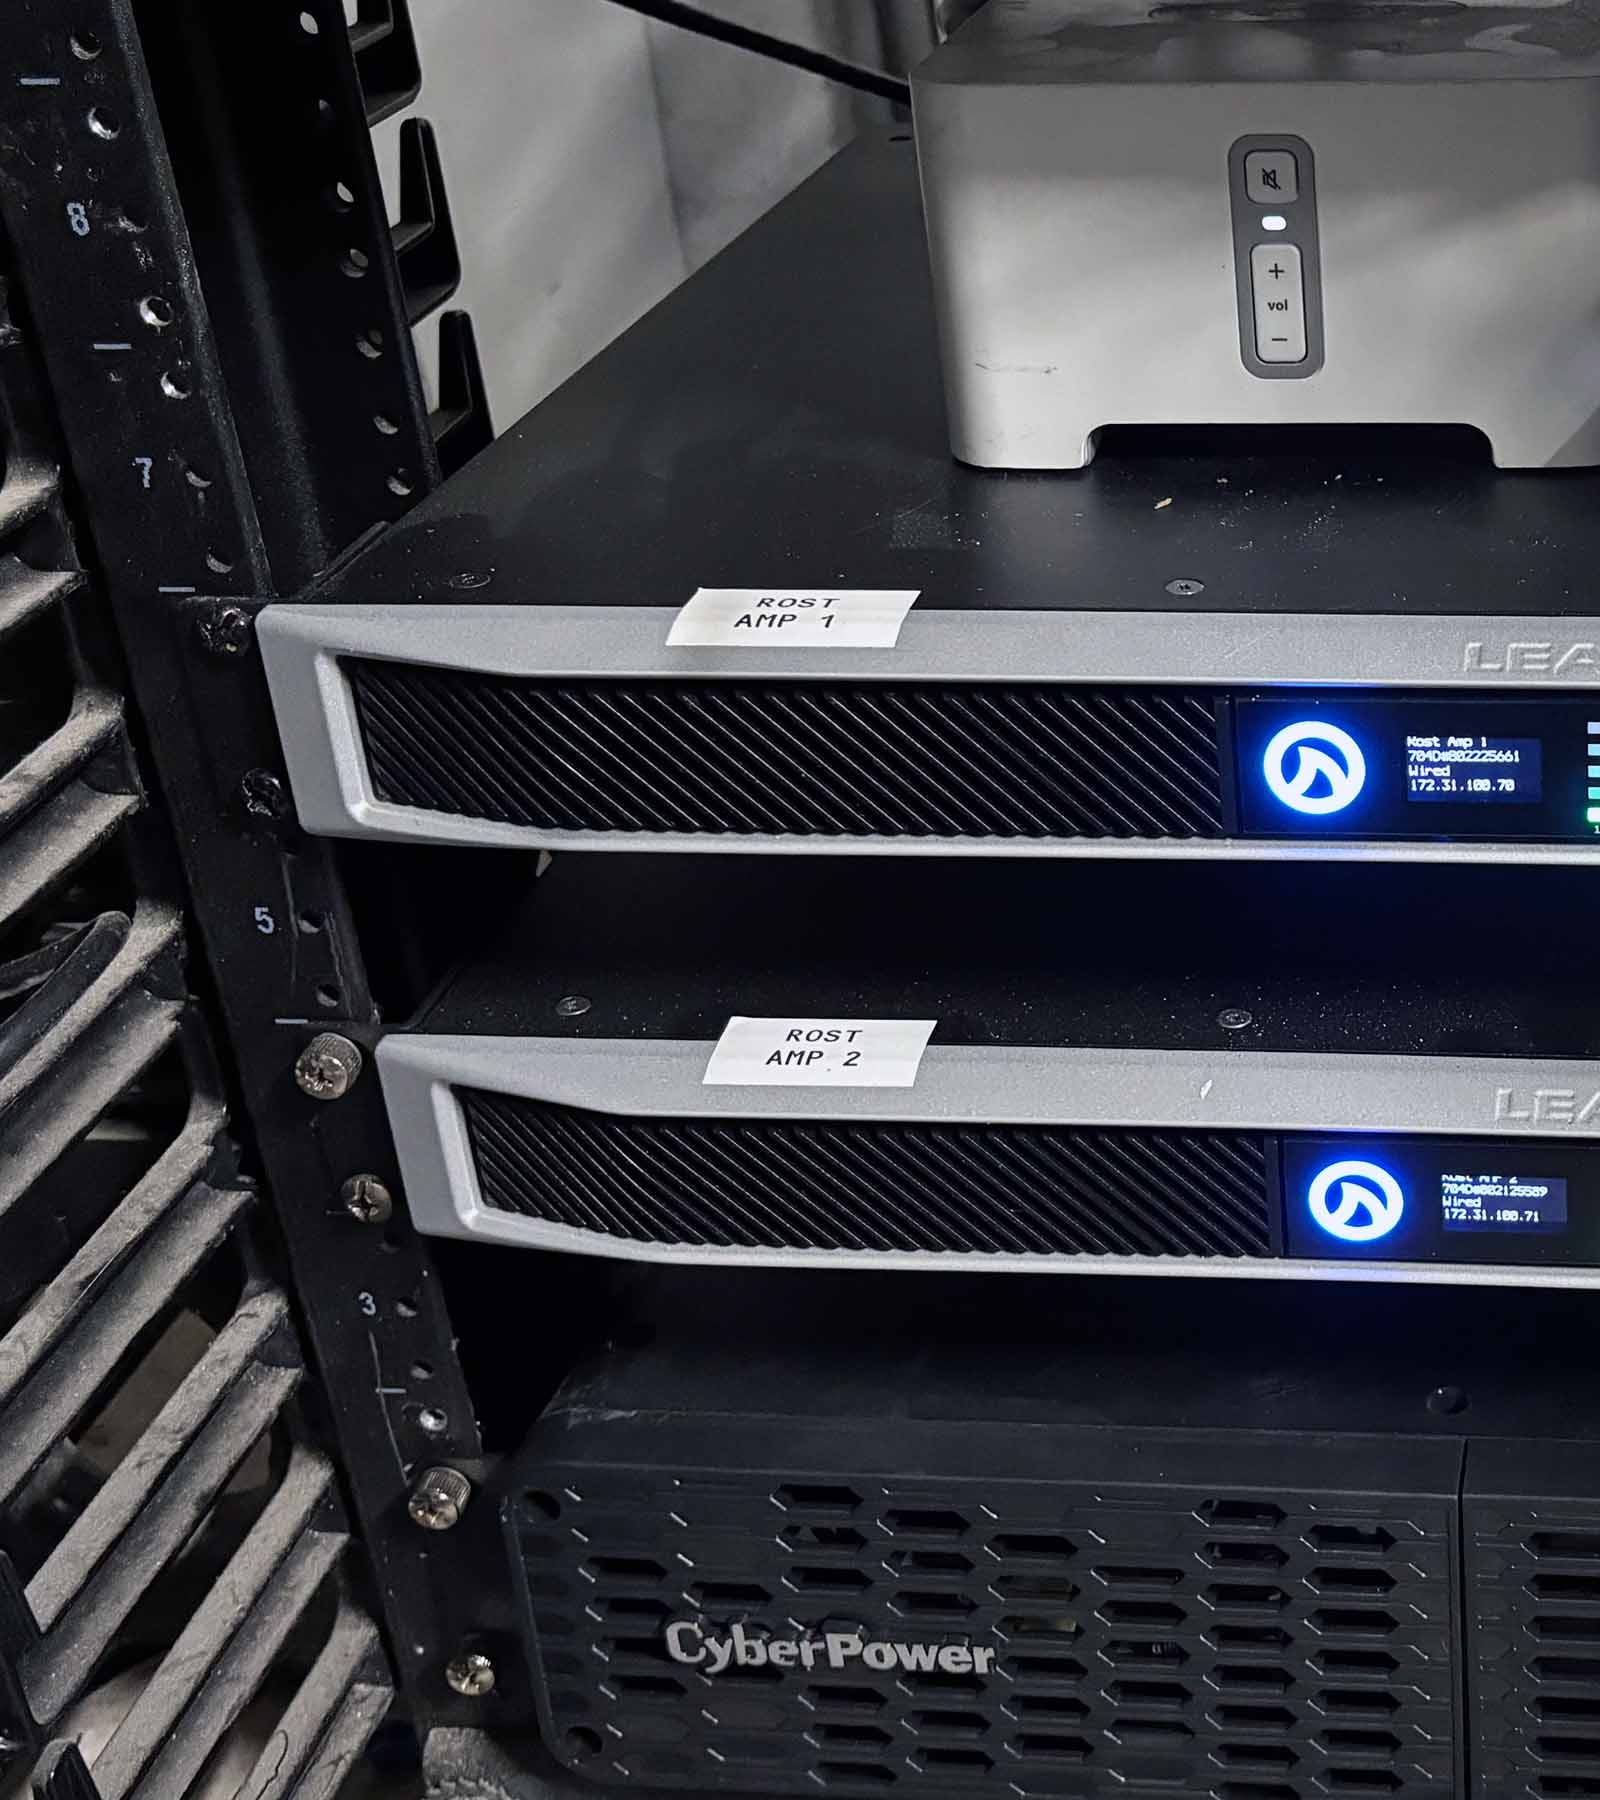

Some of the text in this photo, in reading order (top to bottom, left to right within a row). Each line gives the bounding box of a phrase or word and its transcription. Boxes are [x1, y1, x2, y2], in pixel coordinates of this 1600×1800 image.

[66, 202, 91, 237] 8
[1267, 298, 1289, 312] vol
[132, 456, 153, 489] 7
[756, 597, 841, 609] ROST
[733, 613, 836, 629] AMP 1
[1447, 736, 1474, 750] Amp
[1481, 736, 1488, 748] 1
[1408, 764, 1451, 777] Wired
[1411, 778, 1516, 792] 172.31.100.70
[1593, 825, 1600, 835] 1
[254, 906, 275, 934] 5
[785, 1029, 863, 1043] ROST
[765, 1050, 862, 1067] AMP 2
[1442, 1196, 1482, 1208] Wired
[358, 1291, 377, 1316] 3
[664, 1619, 997, 1675] CyberPower
